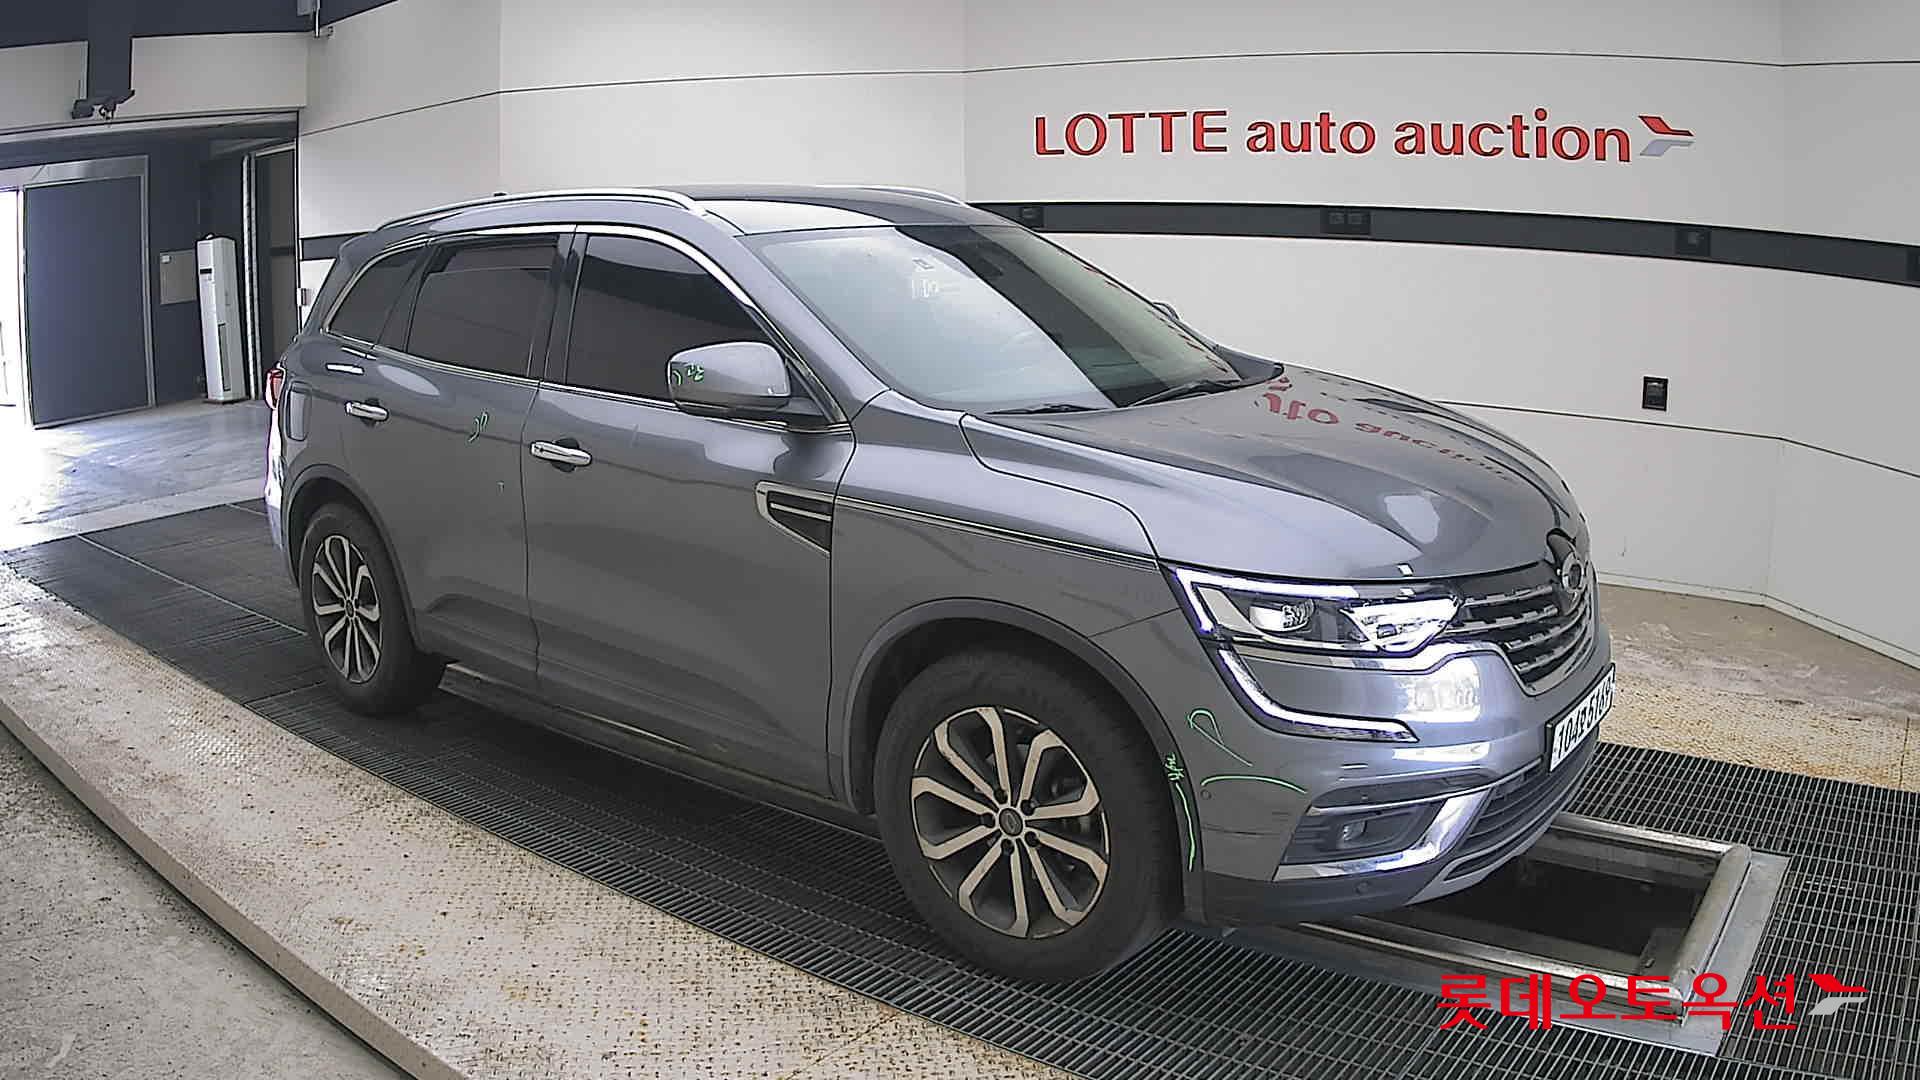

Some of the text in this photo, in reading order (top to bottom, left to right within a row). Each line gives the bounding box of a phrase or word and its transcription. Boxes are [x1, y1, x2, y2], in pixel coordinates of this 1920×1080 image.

[1035, 108, 1631, 162] LOTTE auto auction
